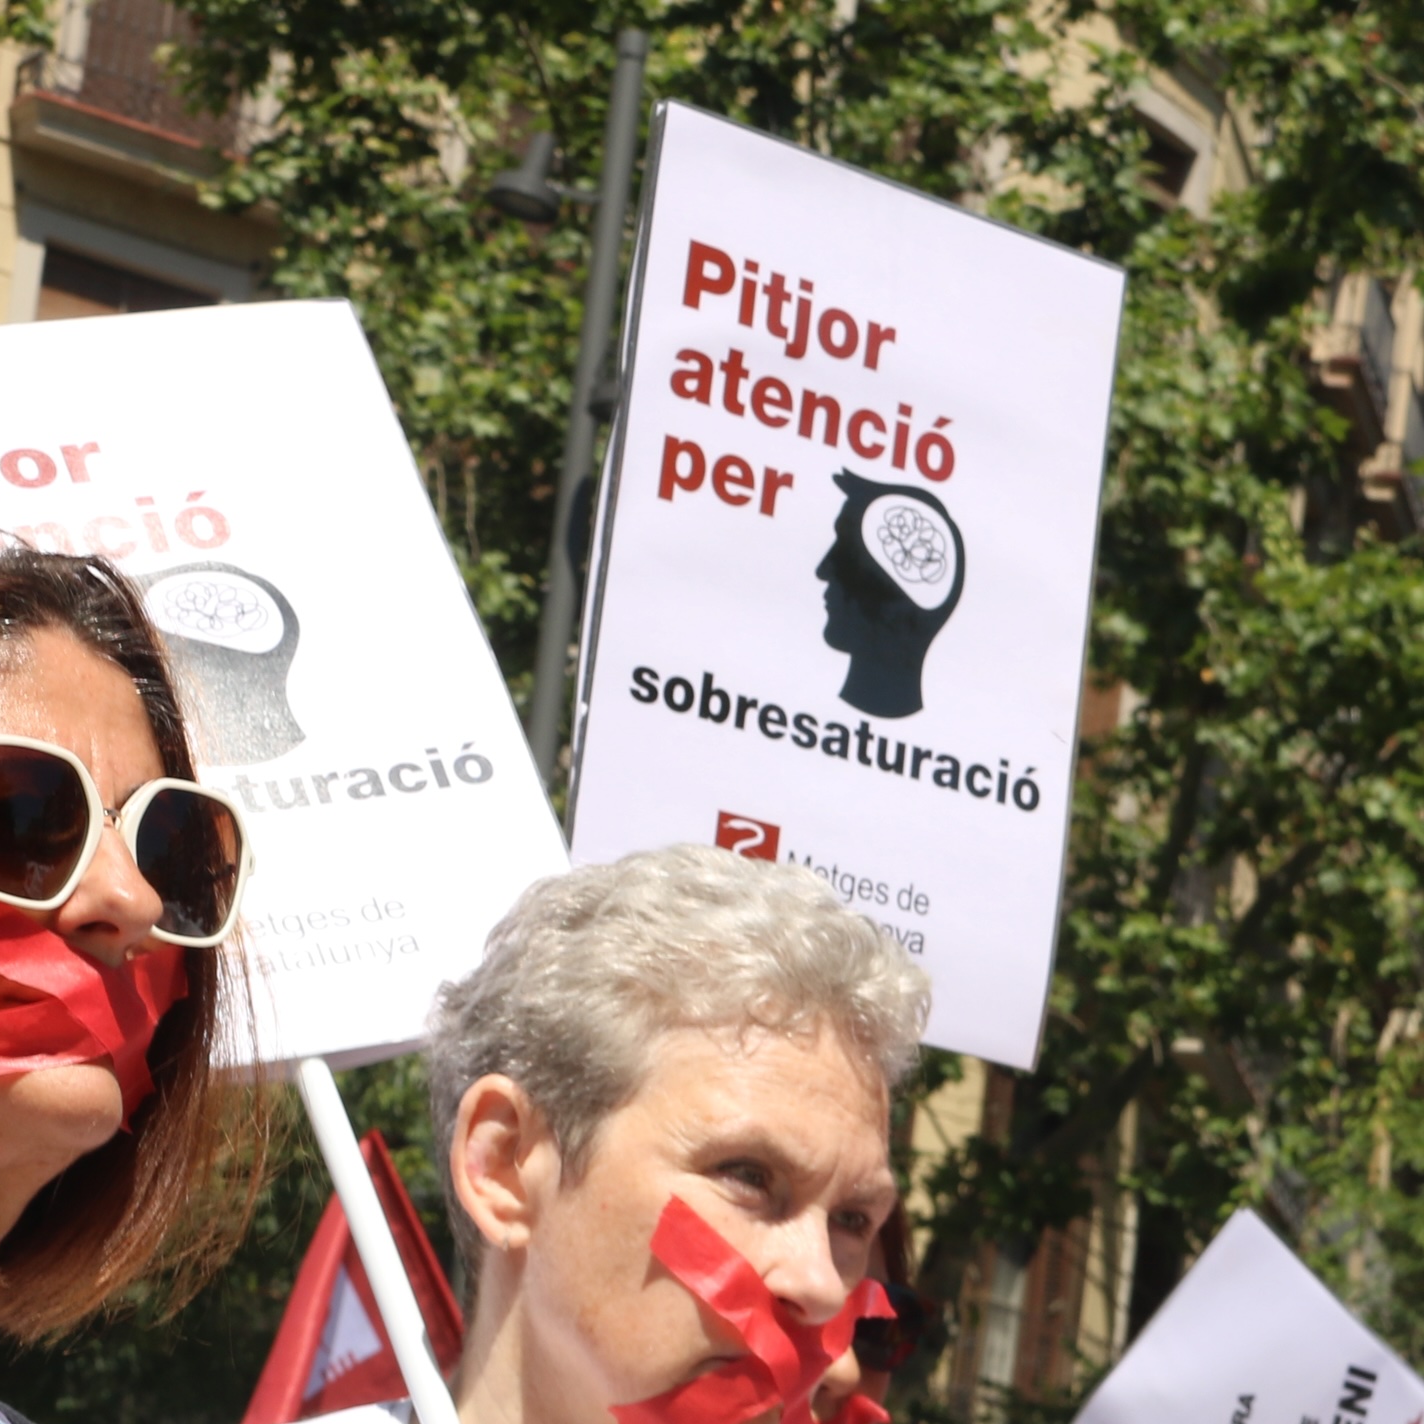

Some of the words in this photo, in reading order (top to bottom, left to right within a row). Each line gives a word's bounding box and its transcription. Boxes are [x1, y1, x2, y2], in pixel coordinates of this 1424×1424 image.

[682, 240, 897, 372] Pitjor
[669, 346, 956, 483] atenció
[656, 432, 794, 518] per
[628, 665, 1041, 814] sobresaturació
[248, 902, 352, 938] etges
[360, 897, 407, 923] de
[896, 883, 931, 917] de
